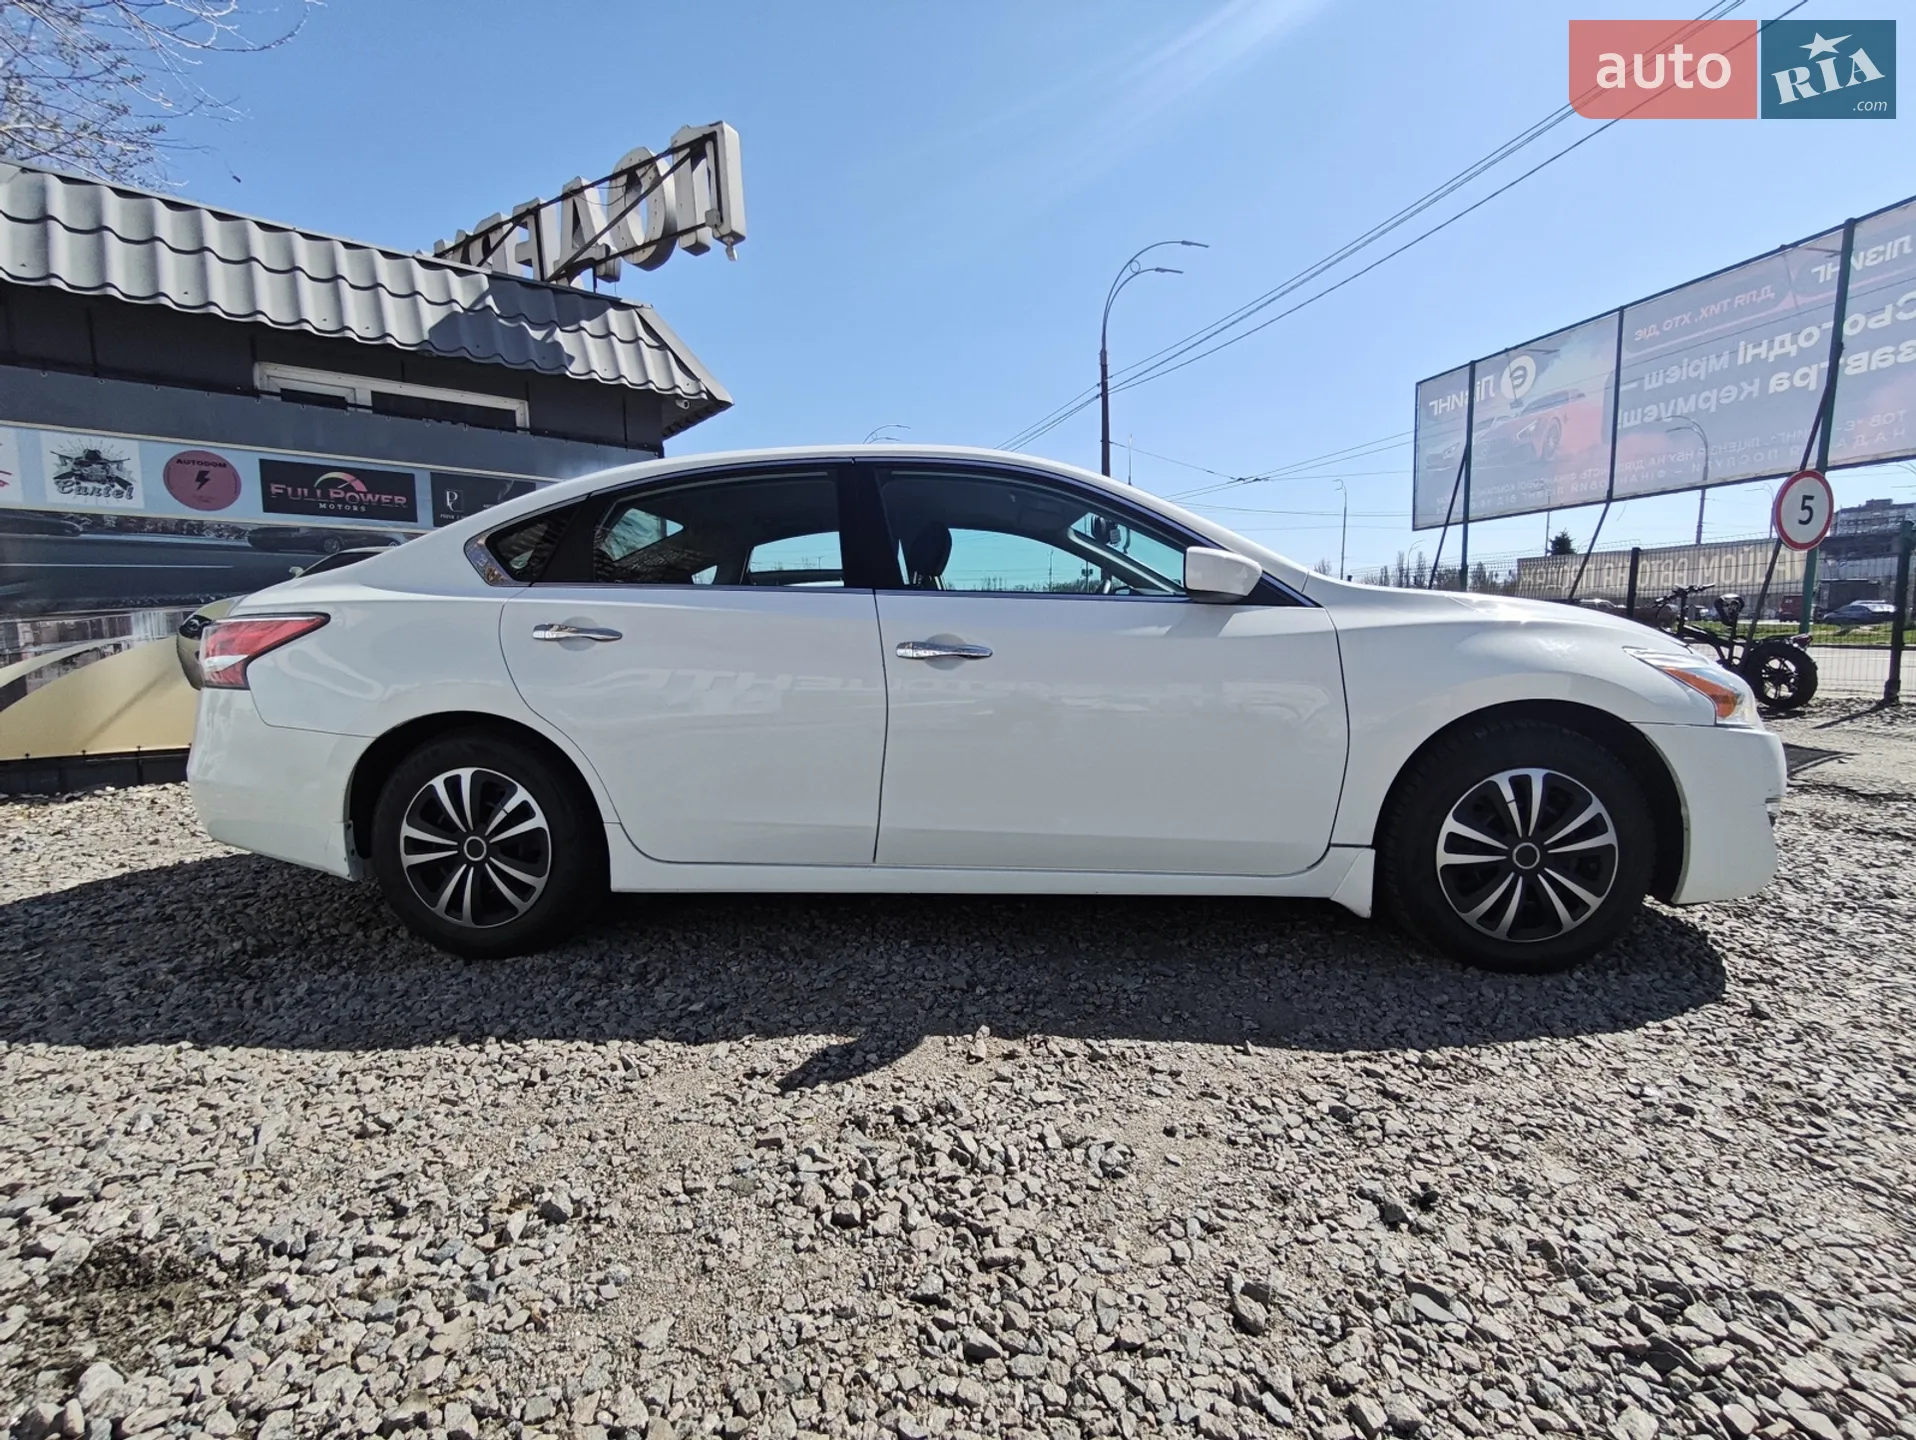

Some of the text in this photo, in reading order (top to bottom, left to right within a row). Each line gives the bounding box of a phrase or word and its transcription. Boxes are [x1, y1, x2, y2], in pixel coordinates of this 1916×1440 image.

[176, 458, 228, 468] AUTODOM
[319, 502, 367, 512] MOTORS
[1798, 494, 1815, 526] 5
